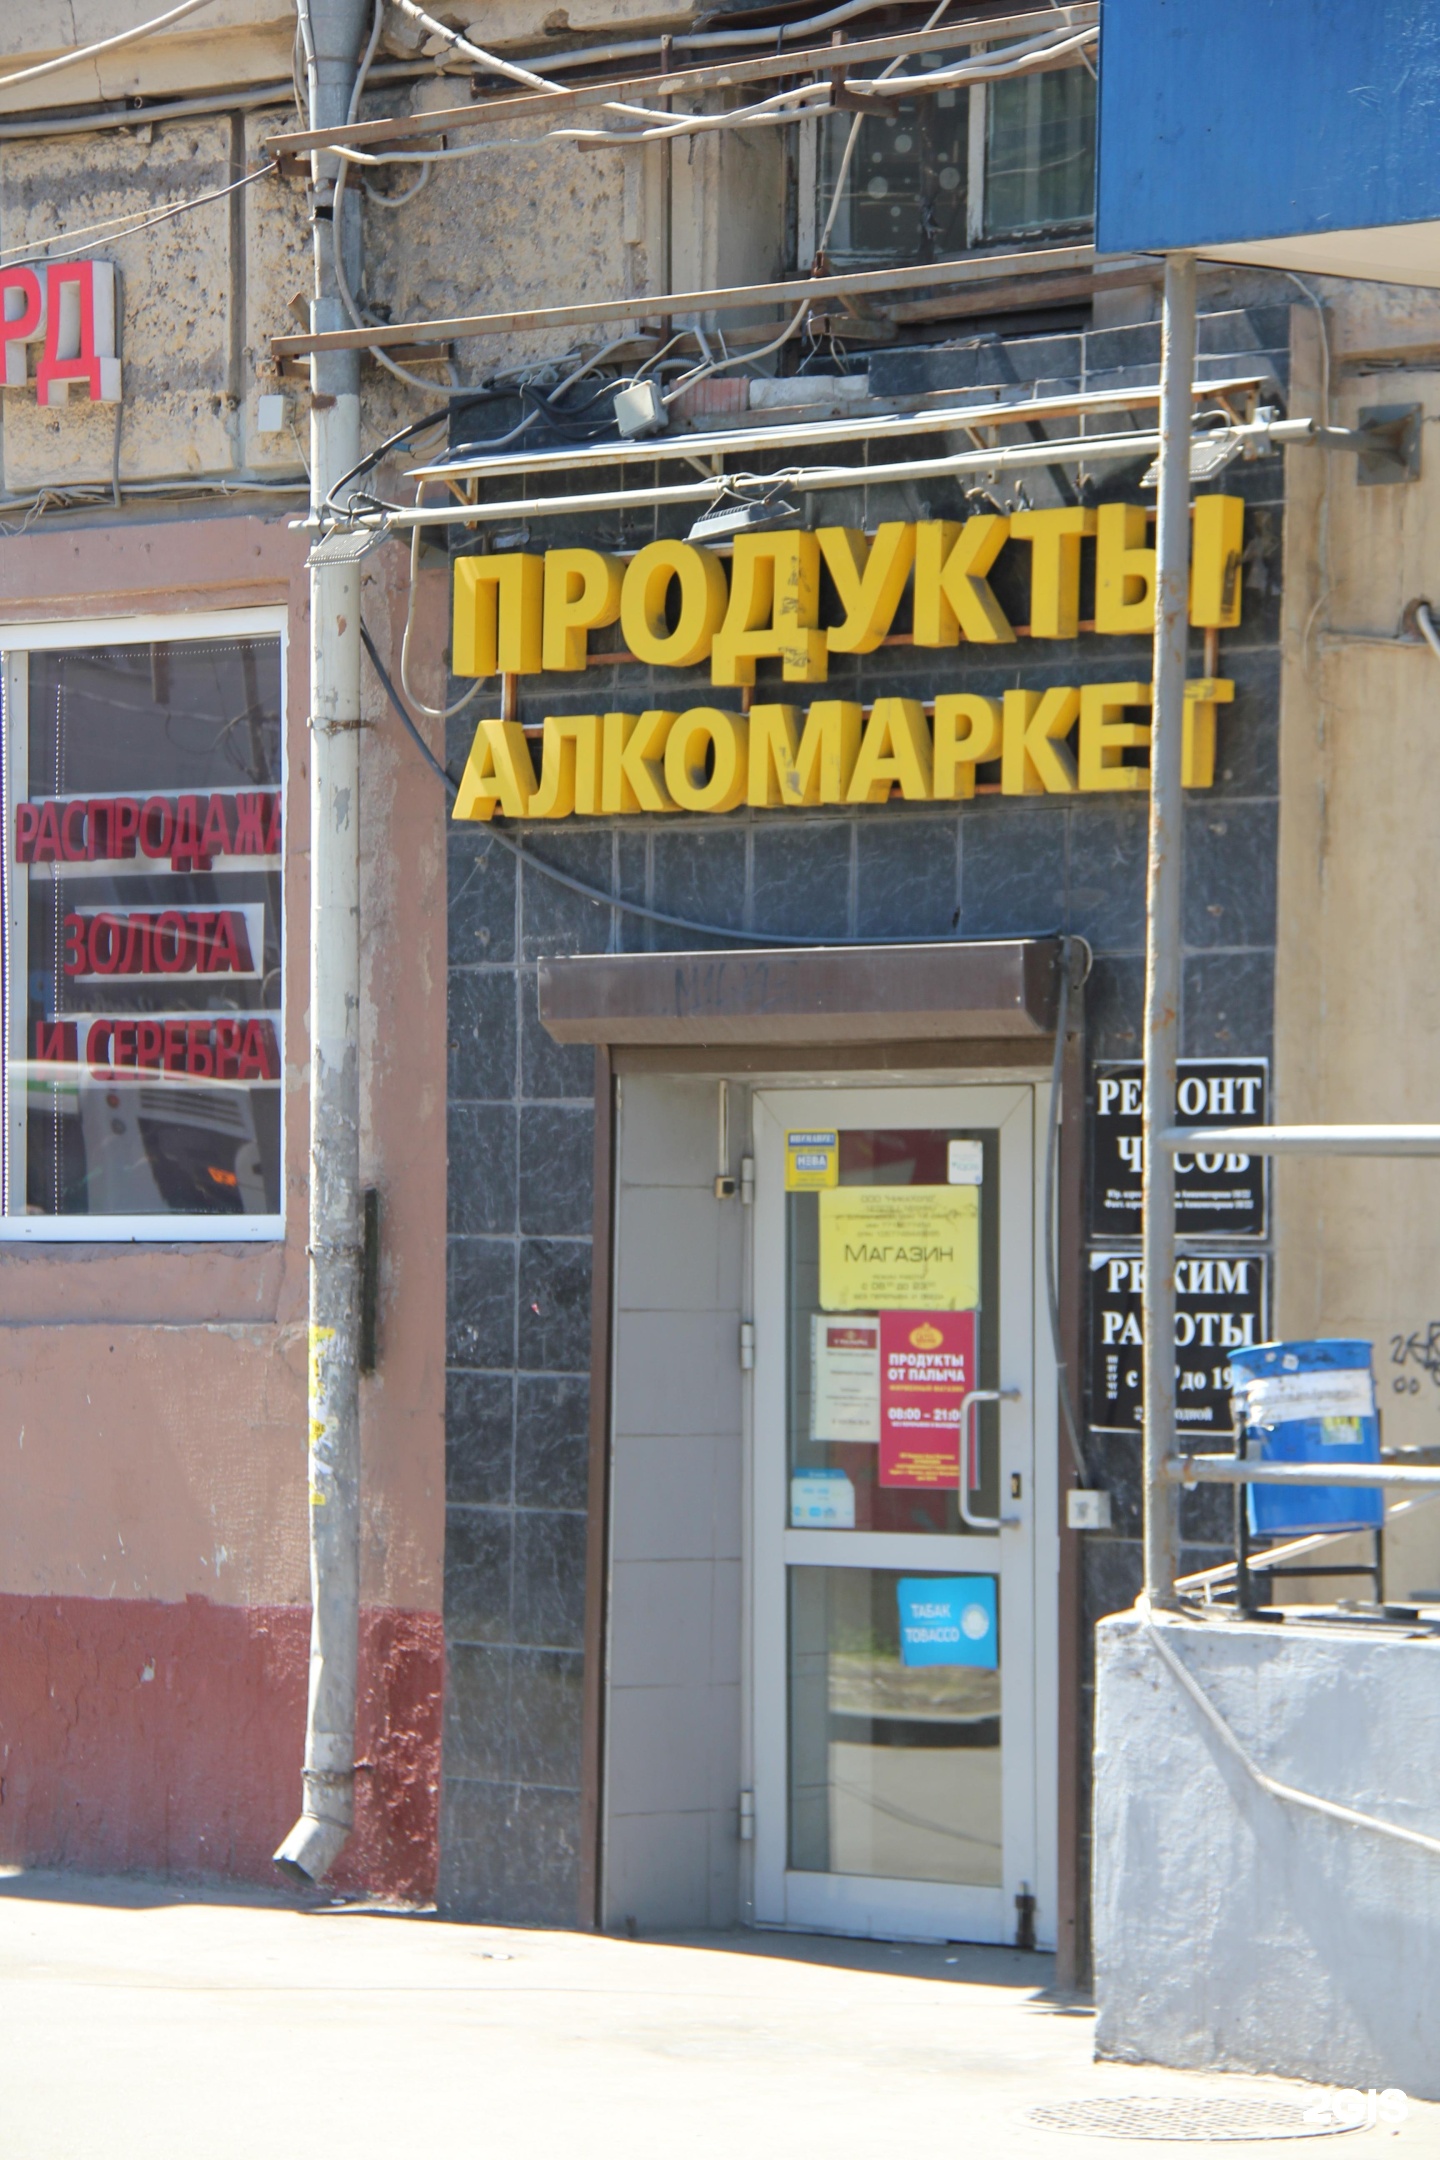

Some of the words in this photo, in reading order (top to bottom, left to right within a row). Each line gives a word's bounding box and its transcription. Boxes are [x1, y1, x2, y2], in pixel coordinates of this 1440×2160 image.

[453, 494, 1244, 688] ПРОДУКТЫ
[452, 678, 1234, 821] АЛКОМАРКЕТ
[63, 911, 255, 976] ЗОЛОТА
[35, 1020, 78, 1081] И
[86, 1018, 281, 1081] СЕРЕБРА
[1097, 1077, 1262, 1115] РЕОНТ
[1117, 1136, 1250, 1173] ЧСОВ
[1102, 1311, 1255, 1347] РАОТЫ
[887, 1368, 906, 1382] ОТ
[908, 1368, 966, 1383] ПАЛЫЧА
[888, 1353, 964, 1368] ПРОДУКТЫ
[933, 1408, 962, 1422] 21:0
[910, 1603, 951, 1619] ТАБАК
[904, 1626, 960, 1643] TOBACCO
